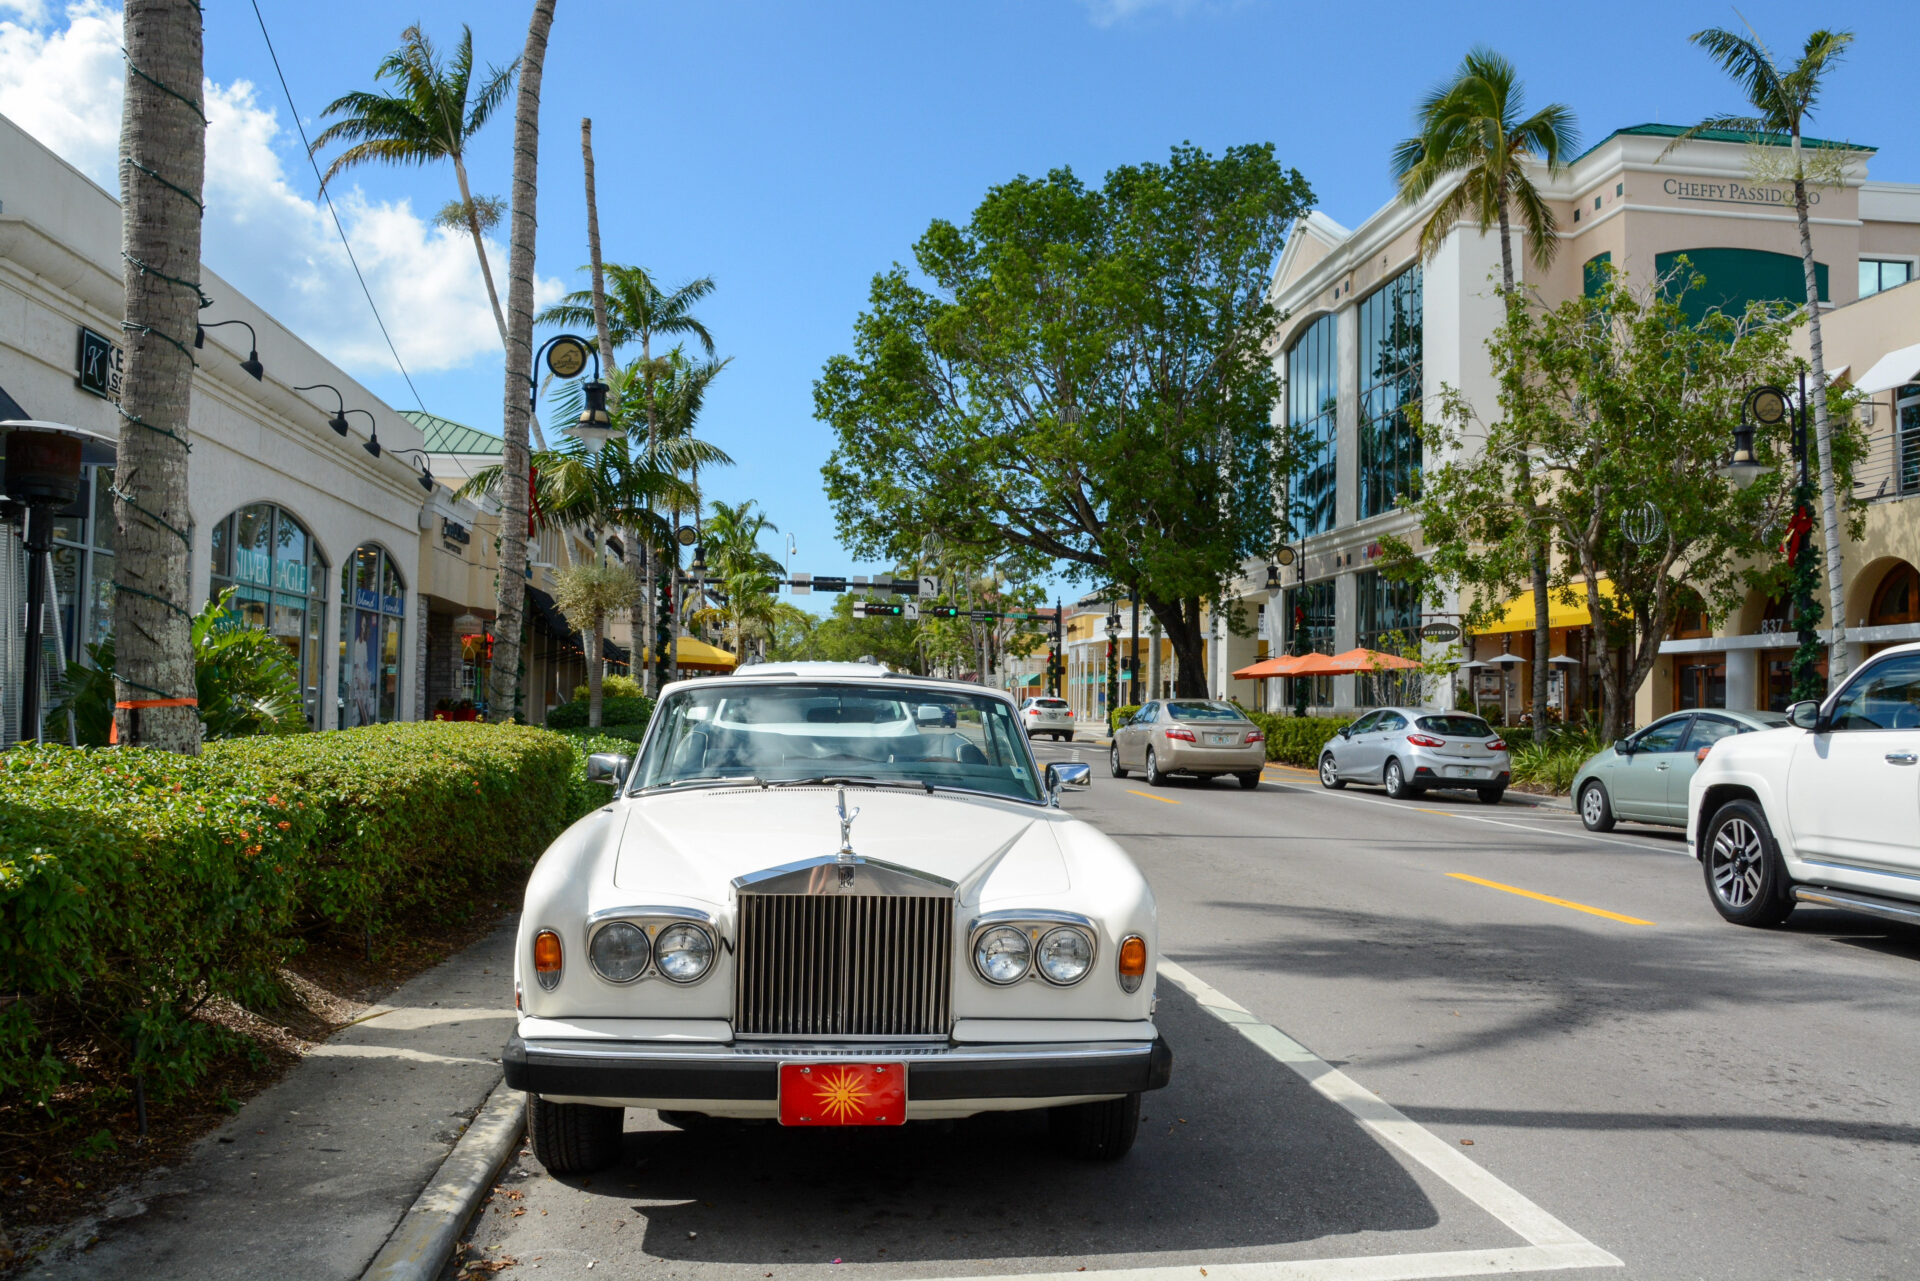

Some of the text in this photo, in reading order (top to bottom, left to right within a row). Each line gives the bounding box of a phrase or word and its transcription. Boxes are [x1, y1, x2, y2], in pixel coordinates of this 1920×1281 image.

[1663, 178, 1821, 205] CHEFFY PASSIDOO
[1761, 618, 1785, 634] 837
